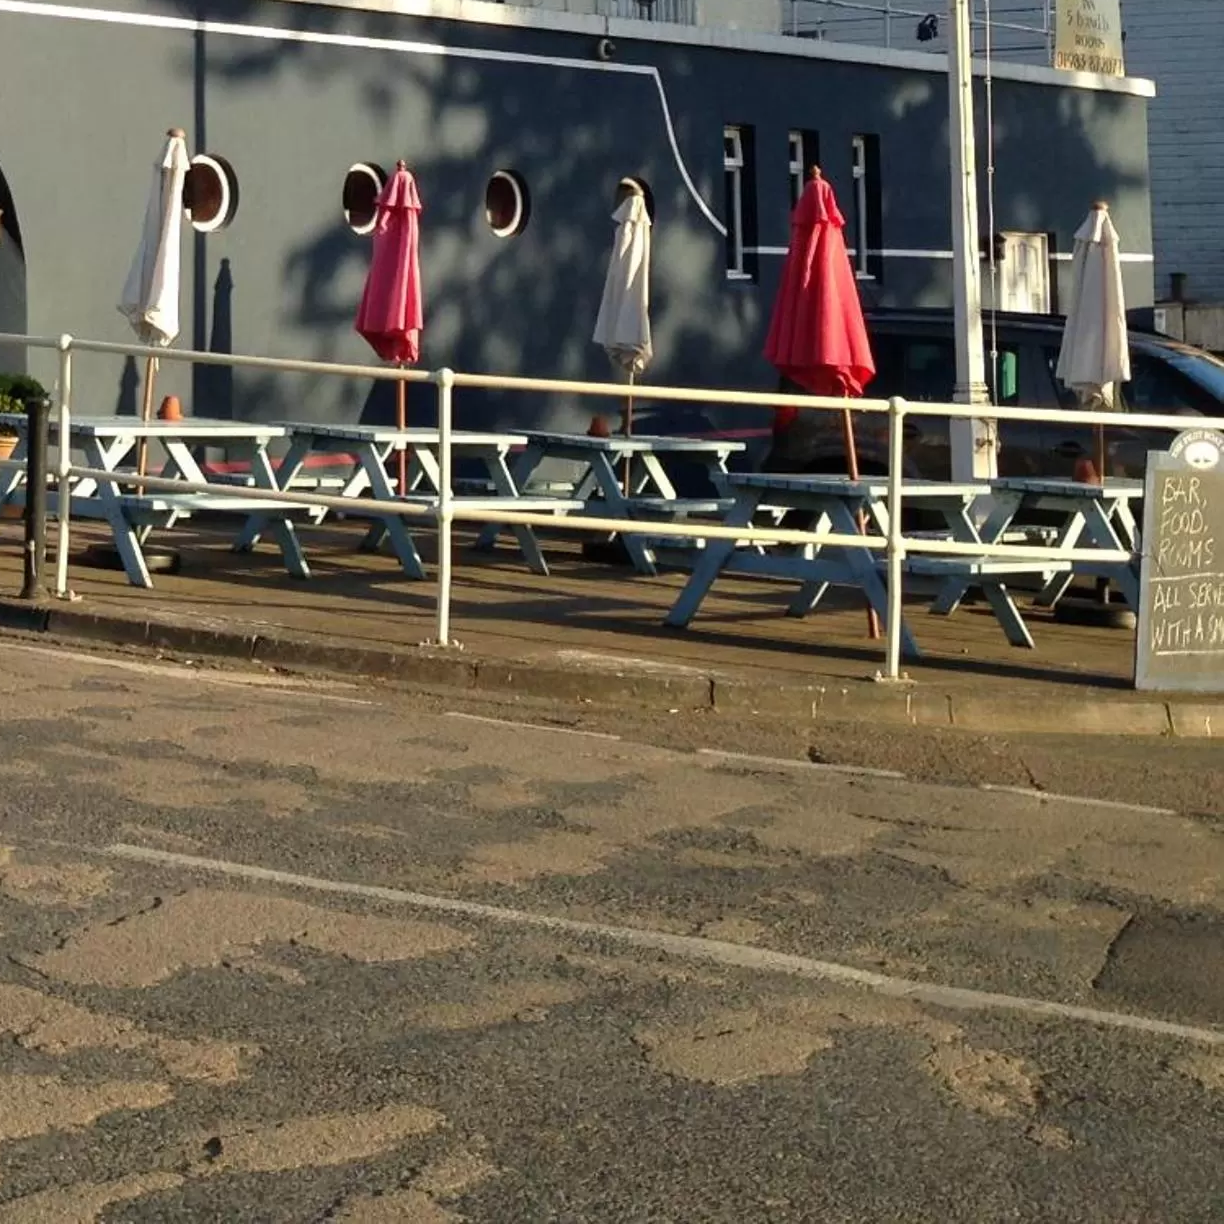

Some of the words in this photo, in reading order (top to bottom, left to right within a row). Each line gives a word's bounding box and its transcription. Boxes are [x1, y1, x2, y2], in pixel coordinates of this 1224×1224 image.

[1162, 476, 1207, 509] BAR,
[1158, 537, 1214, 569] ROOMS
[1153, 582, 1182, 613] ALL
[1151, 615, 1192, 651] WITH
[1194, 613, 1204, 642] A
